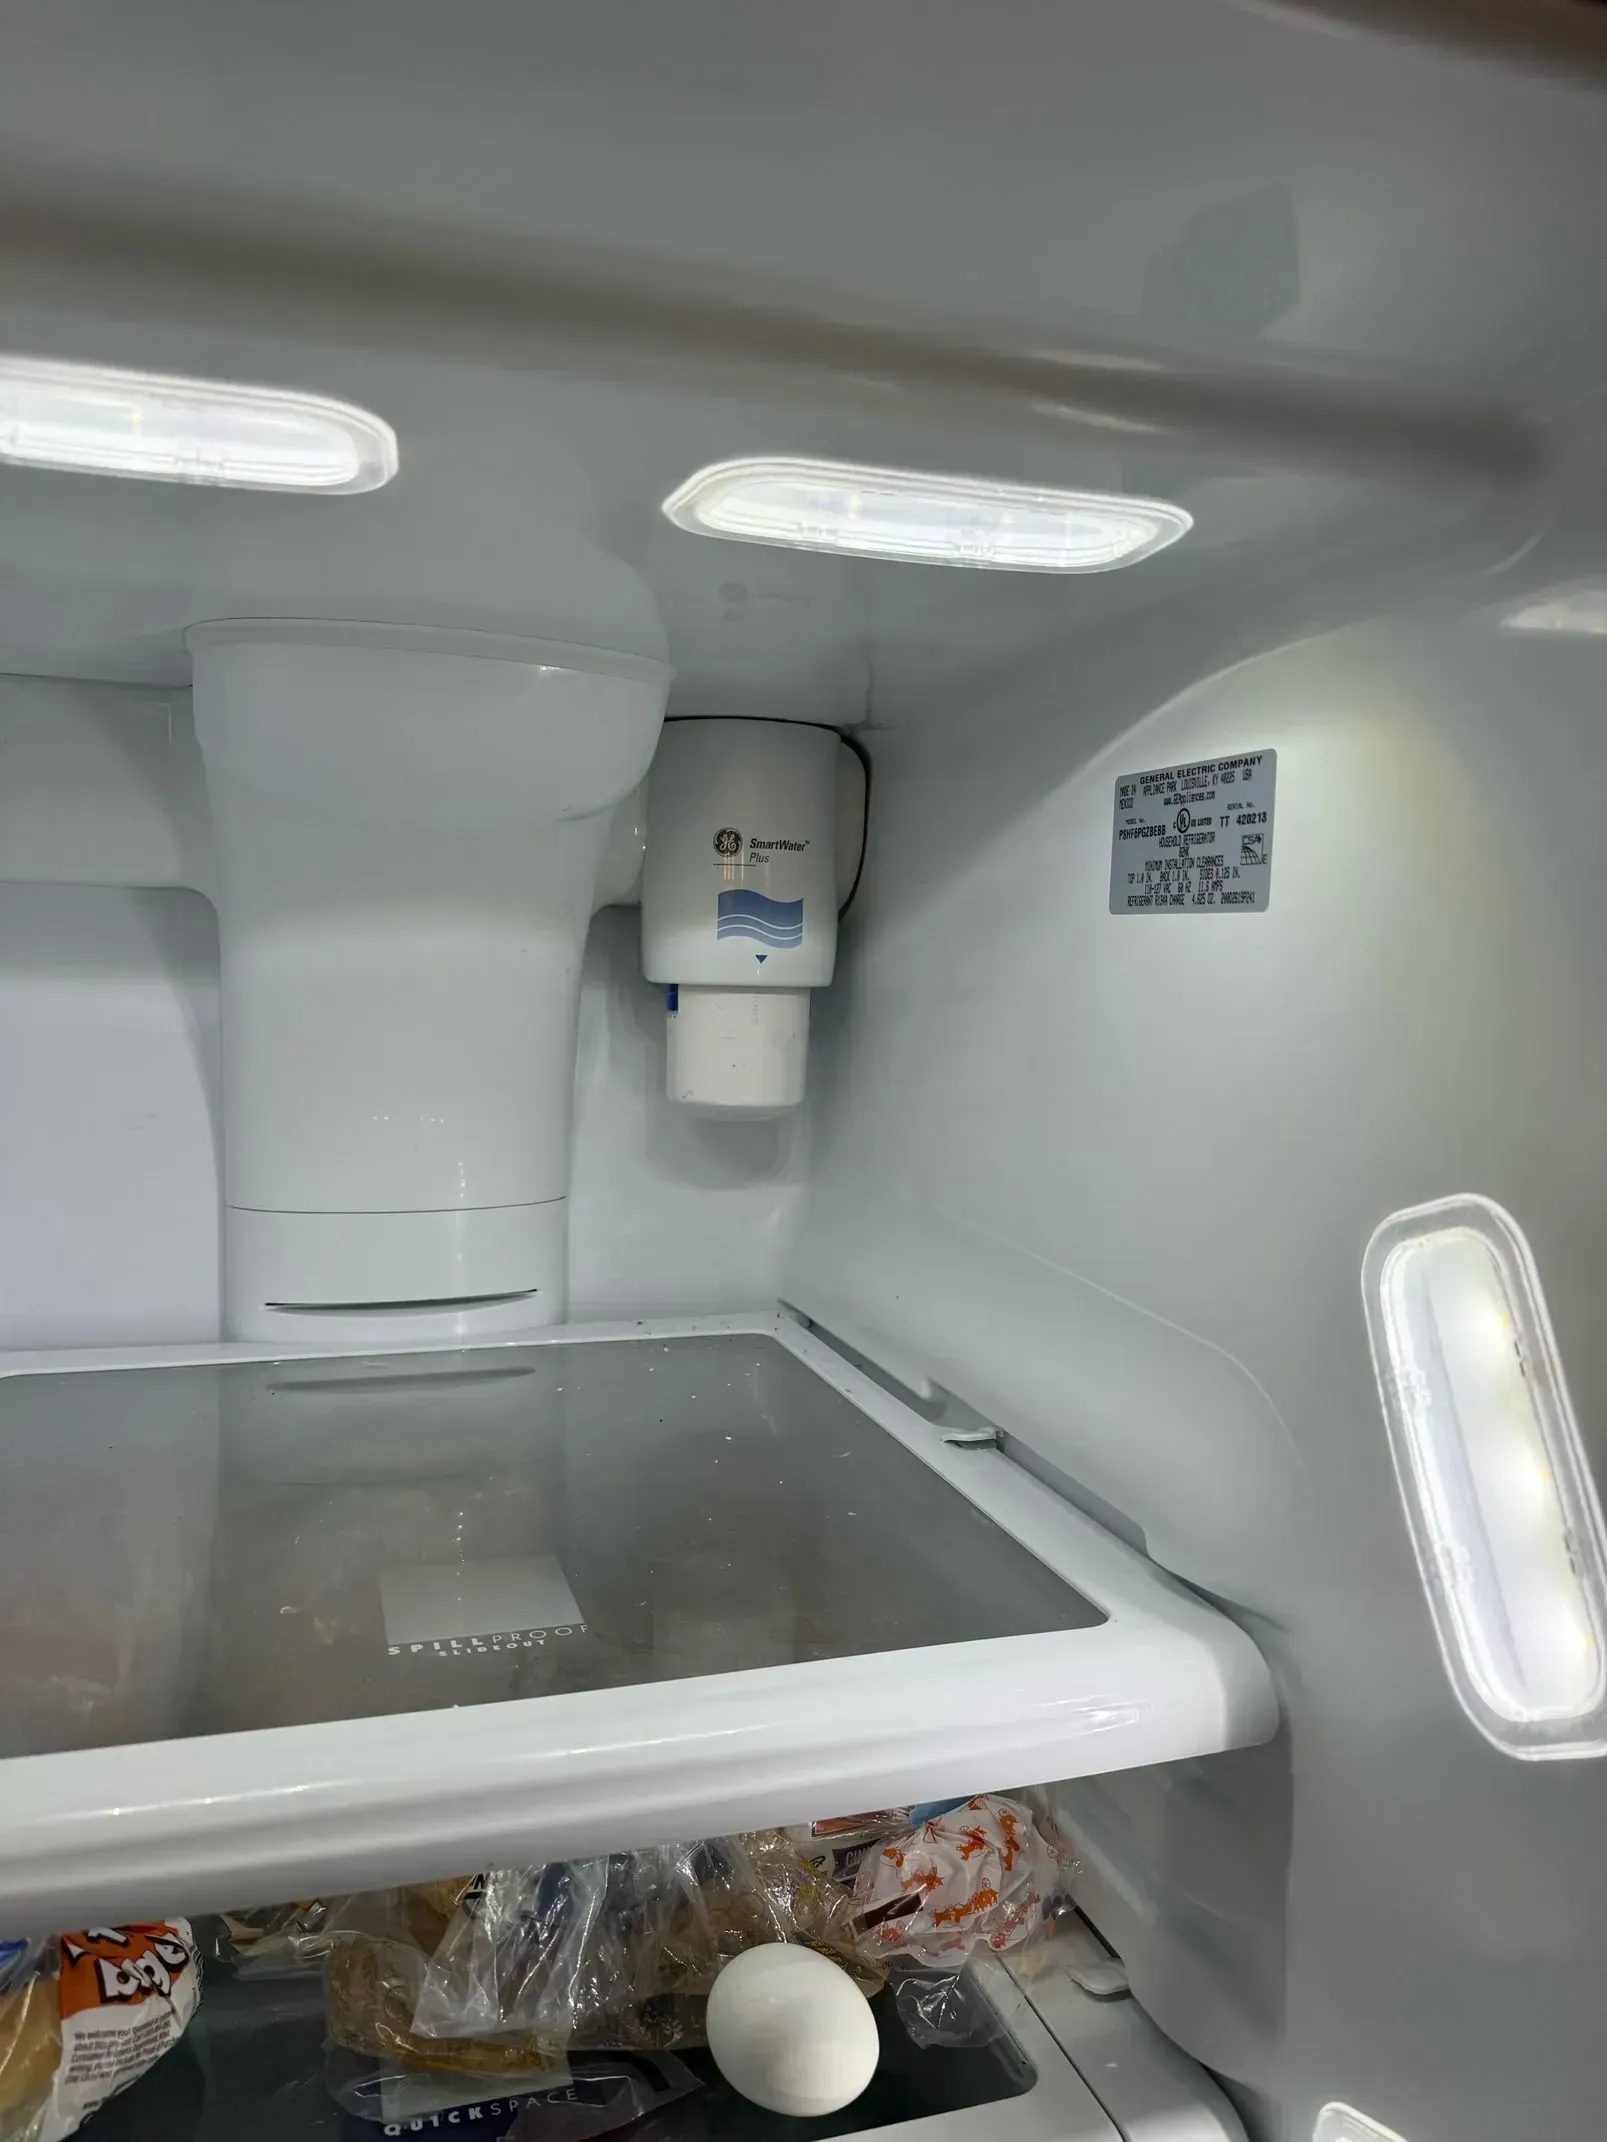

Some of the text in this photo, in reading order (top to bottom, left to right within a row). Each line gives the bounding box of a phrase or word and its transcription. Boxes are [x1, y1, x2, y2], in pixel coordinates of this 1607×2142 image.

[1140, 756, 1262, 785] GENERAL ELECTRIC COMPANY
[1143, 782, 1165, 797] APPLIANCE
[1166, 780, 1177, 793] PARK
[1212, 773, 1219, 785] KY
[1242, 768, 1252, 781] USA
[1197, 817, 1212, 827] LISTED
[1220, 812, 1267, 828] TT 420213
[1159, 831, 1216, 848] HOUSEHOLD REFRIGERATOR
[749, 852, 770, 863] Plus
[1145, 855, 1224, 871] MINIMUM INSTALLATION CLEARANCES
[1127, 895, 1154, 907] REFRIGERANT
